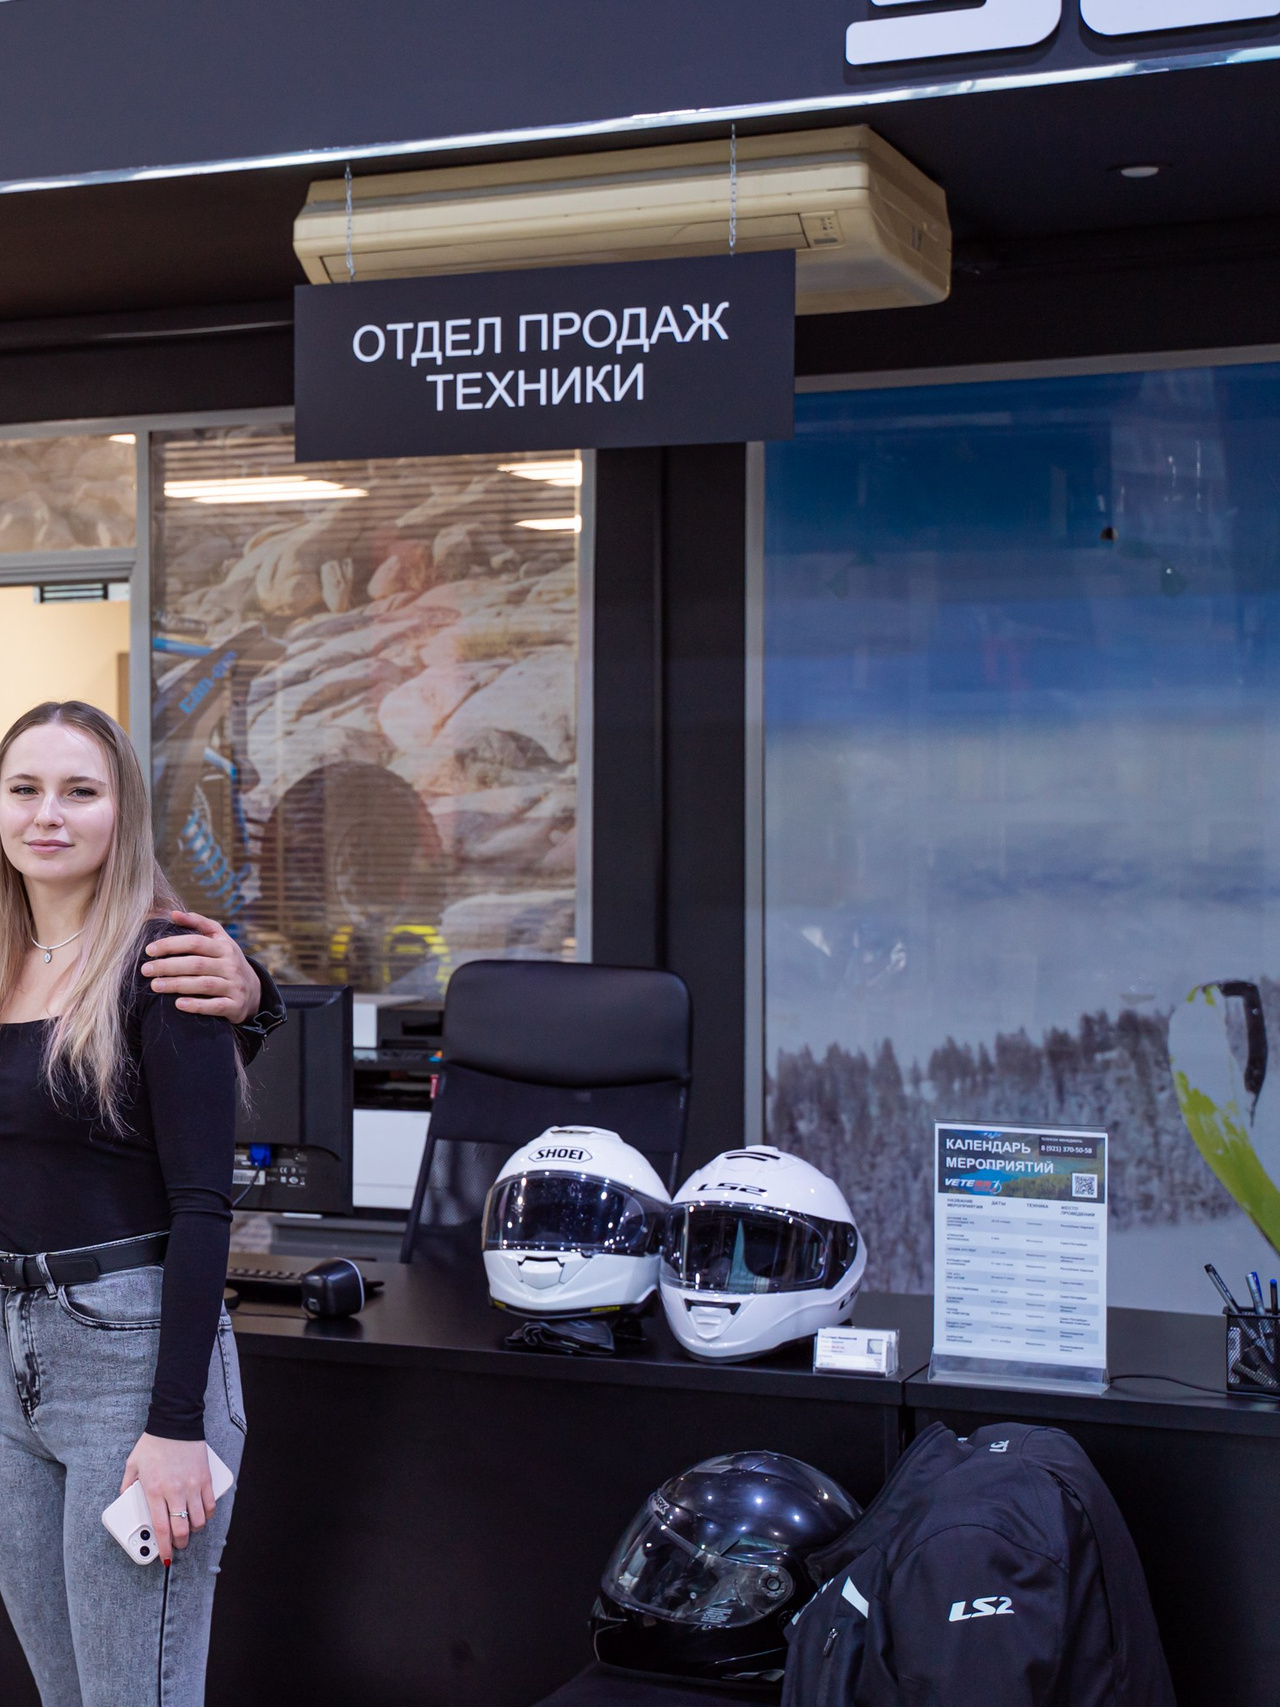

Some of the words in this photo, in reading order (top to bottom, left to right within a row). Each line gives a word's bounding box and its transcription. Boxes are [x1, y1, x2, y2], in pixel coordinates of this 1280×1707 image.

[352, 315, 503, 367] ОТДЕЛ
[518, 301, 730, 355] ПРОДАЖ
[426, 363, 645, 413] ТЕХНИКИ
[536, 1149, 583, 1161] SHOEI
[946, 1138, 1031, 1154] КАЛЕНДАРЬ
[946, 1156, 1054, 1174] МЕРОПРИЯТИЙ
[697, 1182, 768, 1197] LS2
[948, 1596, 1015, 1622] LS2
